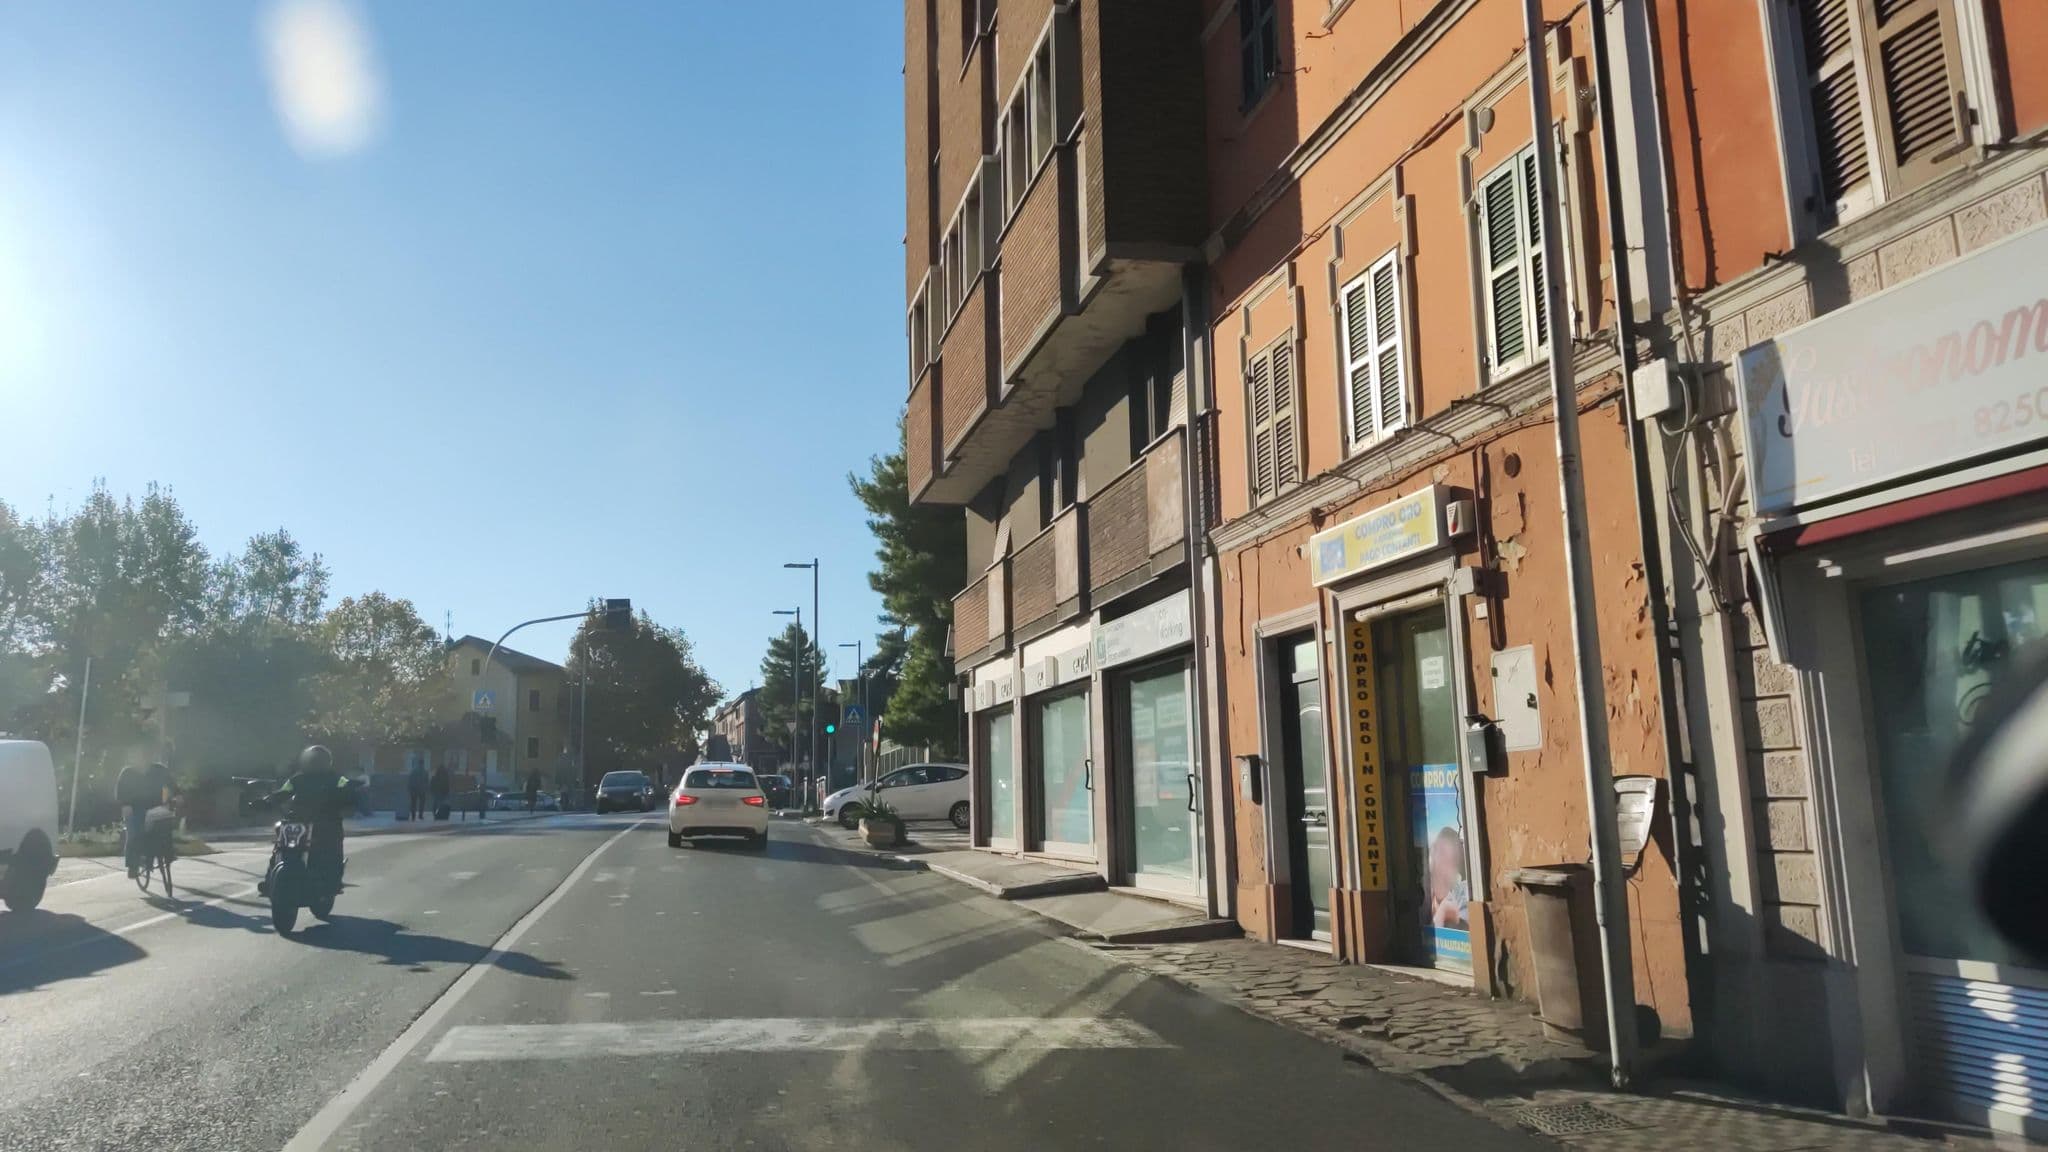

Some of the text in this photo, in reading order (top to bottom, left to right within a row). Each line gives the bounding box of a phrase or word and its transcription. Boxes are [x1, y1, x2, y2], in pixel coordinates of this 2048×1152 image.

[1355, 511, 1397, 540] COMPRO
[1399, 501, 1422, 523] ORO
[1353, 628, 1379, 886] COMPRO ORO IN CONTANTI
